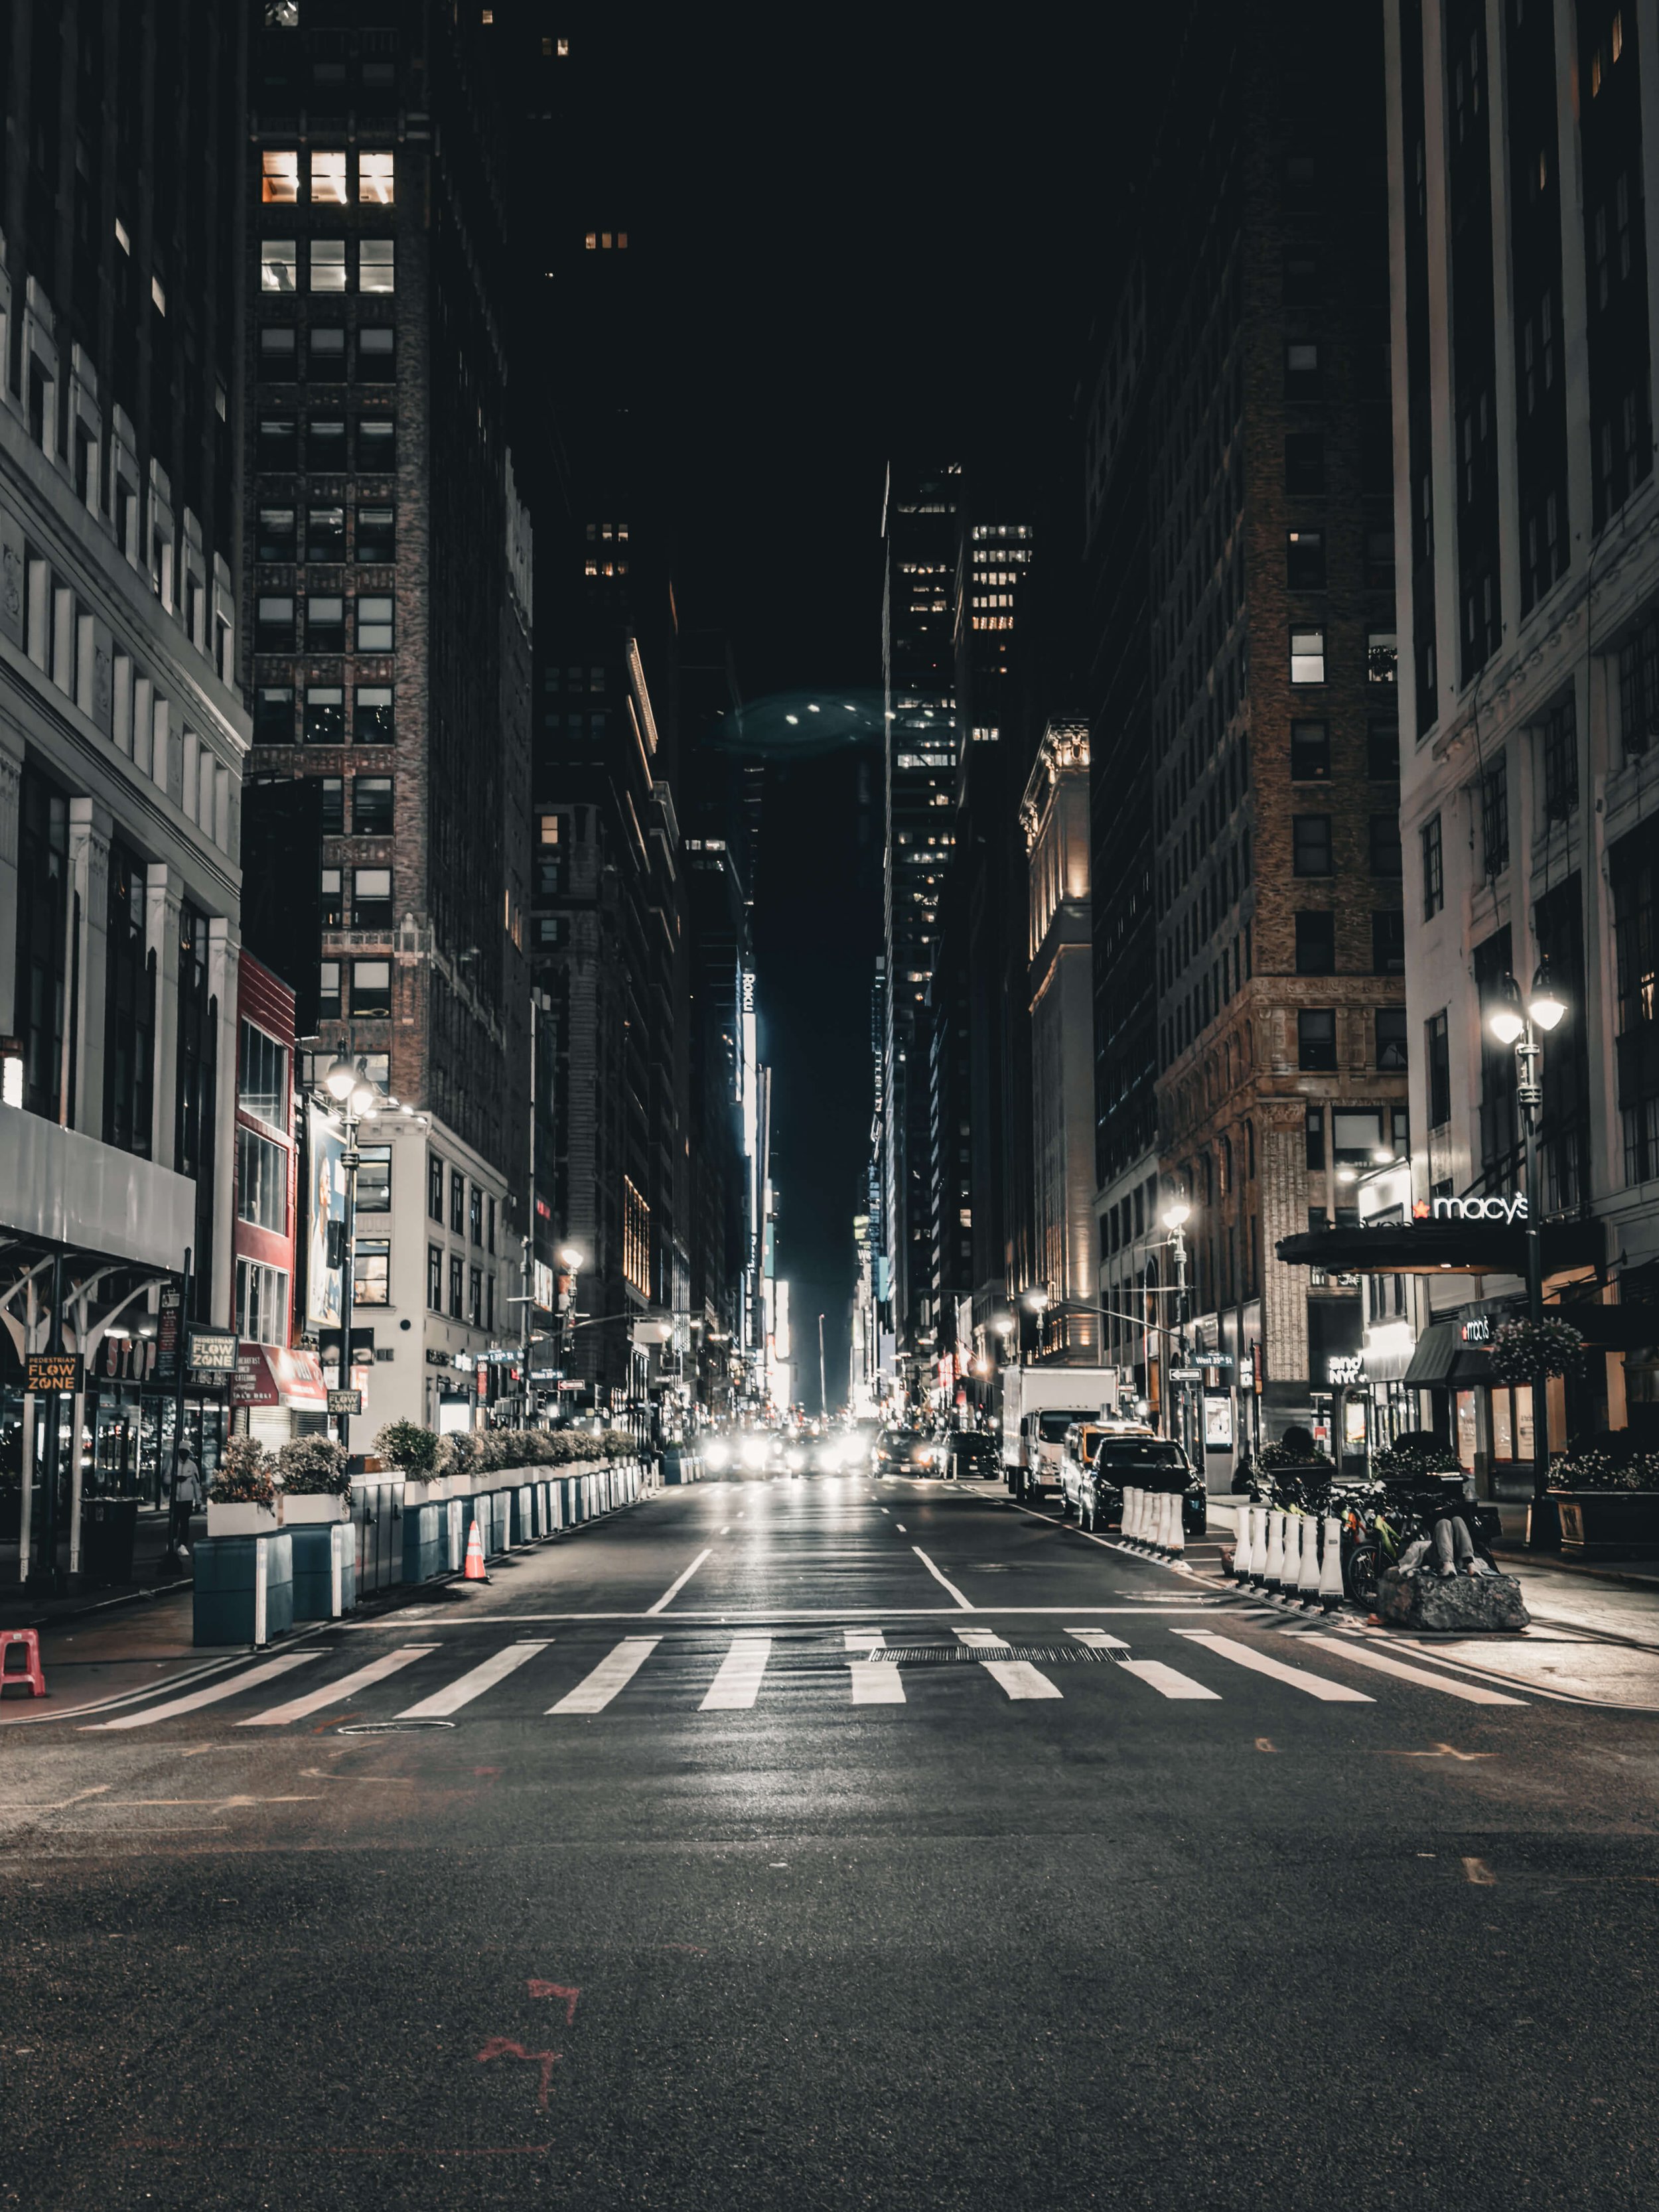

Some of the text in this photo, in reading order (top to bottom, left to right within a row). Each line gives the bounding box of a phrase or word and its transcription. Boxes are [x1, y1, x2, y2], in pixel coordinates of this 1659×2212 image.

[1433, 1191, 1528, 1225] macy's
[193, 1344, 233, 1355] FLOW
[192, 1354, 232, 1367] ZONE
[1196, 1356, 1212, 1365] West
[29, 1364, 75, 1376] FLOW
[28, 1377, 75, 1389] ZONE
[328, 1395, 358, 1404] FLOW
[328, 1403, 358, 1413] ZONE
